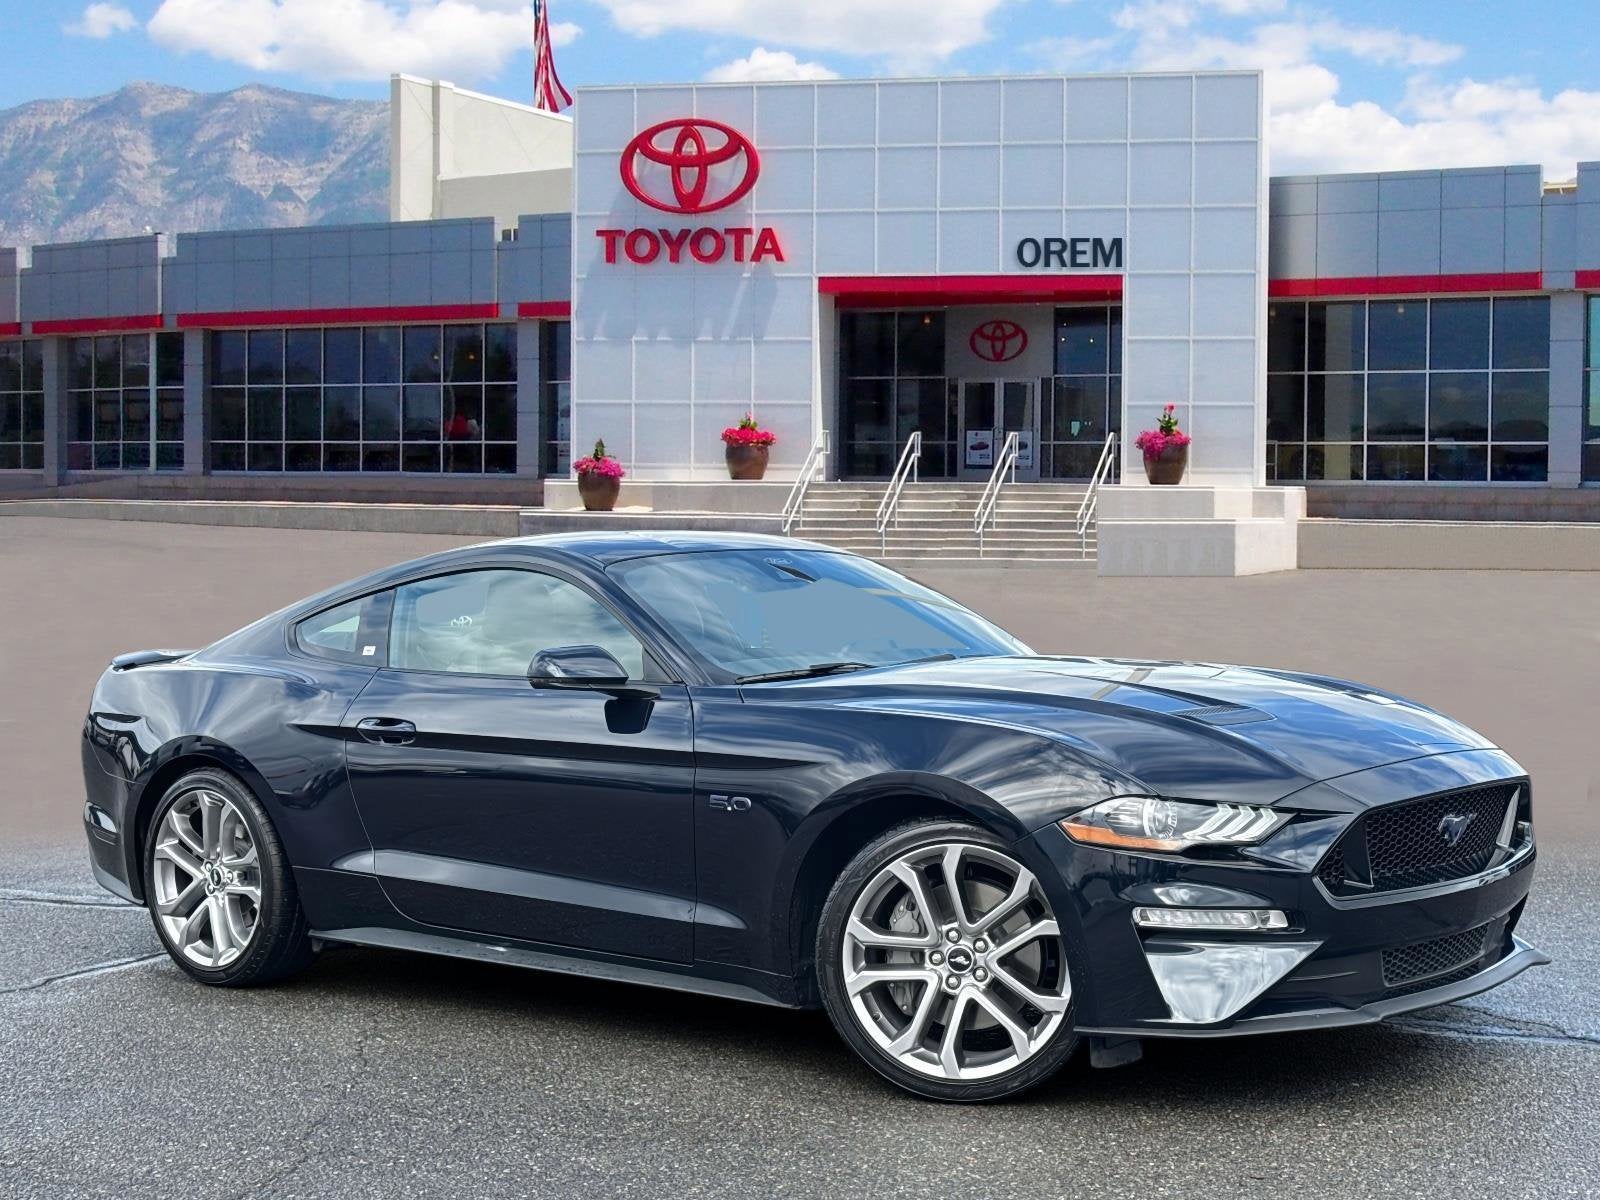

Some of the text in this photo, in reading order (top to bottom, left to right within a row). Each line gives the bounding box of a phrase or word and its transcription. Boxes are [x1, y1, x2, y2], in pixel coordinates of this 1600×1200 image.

[596, 227, 784, 264] TOYOTA
[1017, 237, 1123, 268] OREM
[709, 794, 752, 812] 5.0
